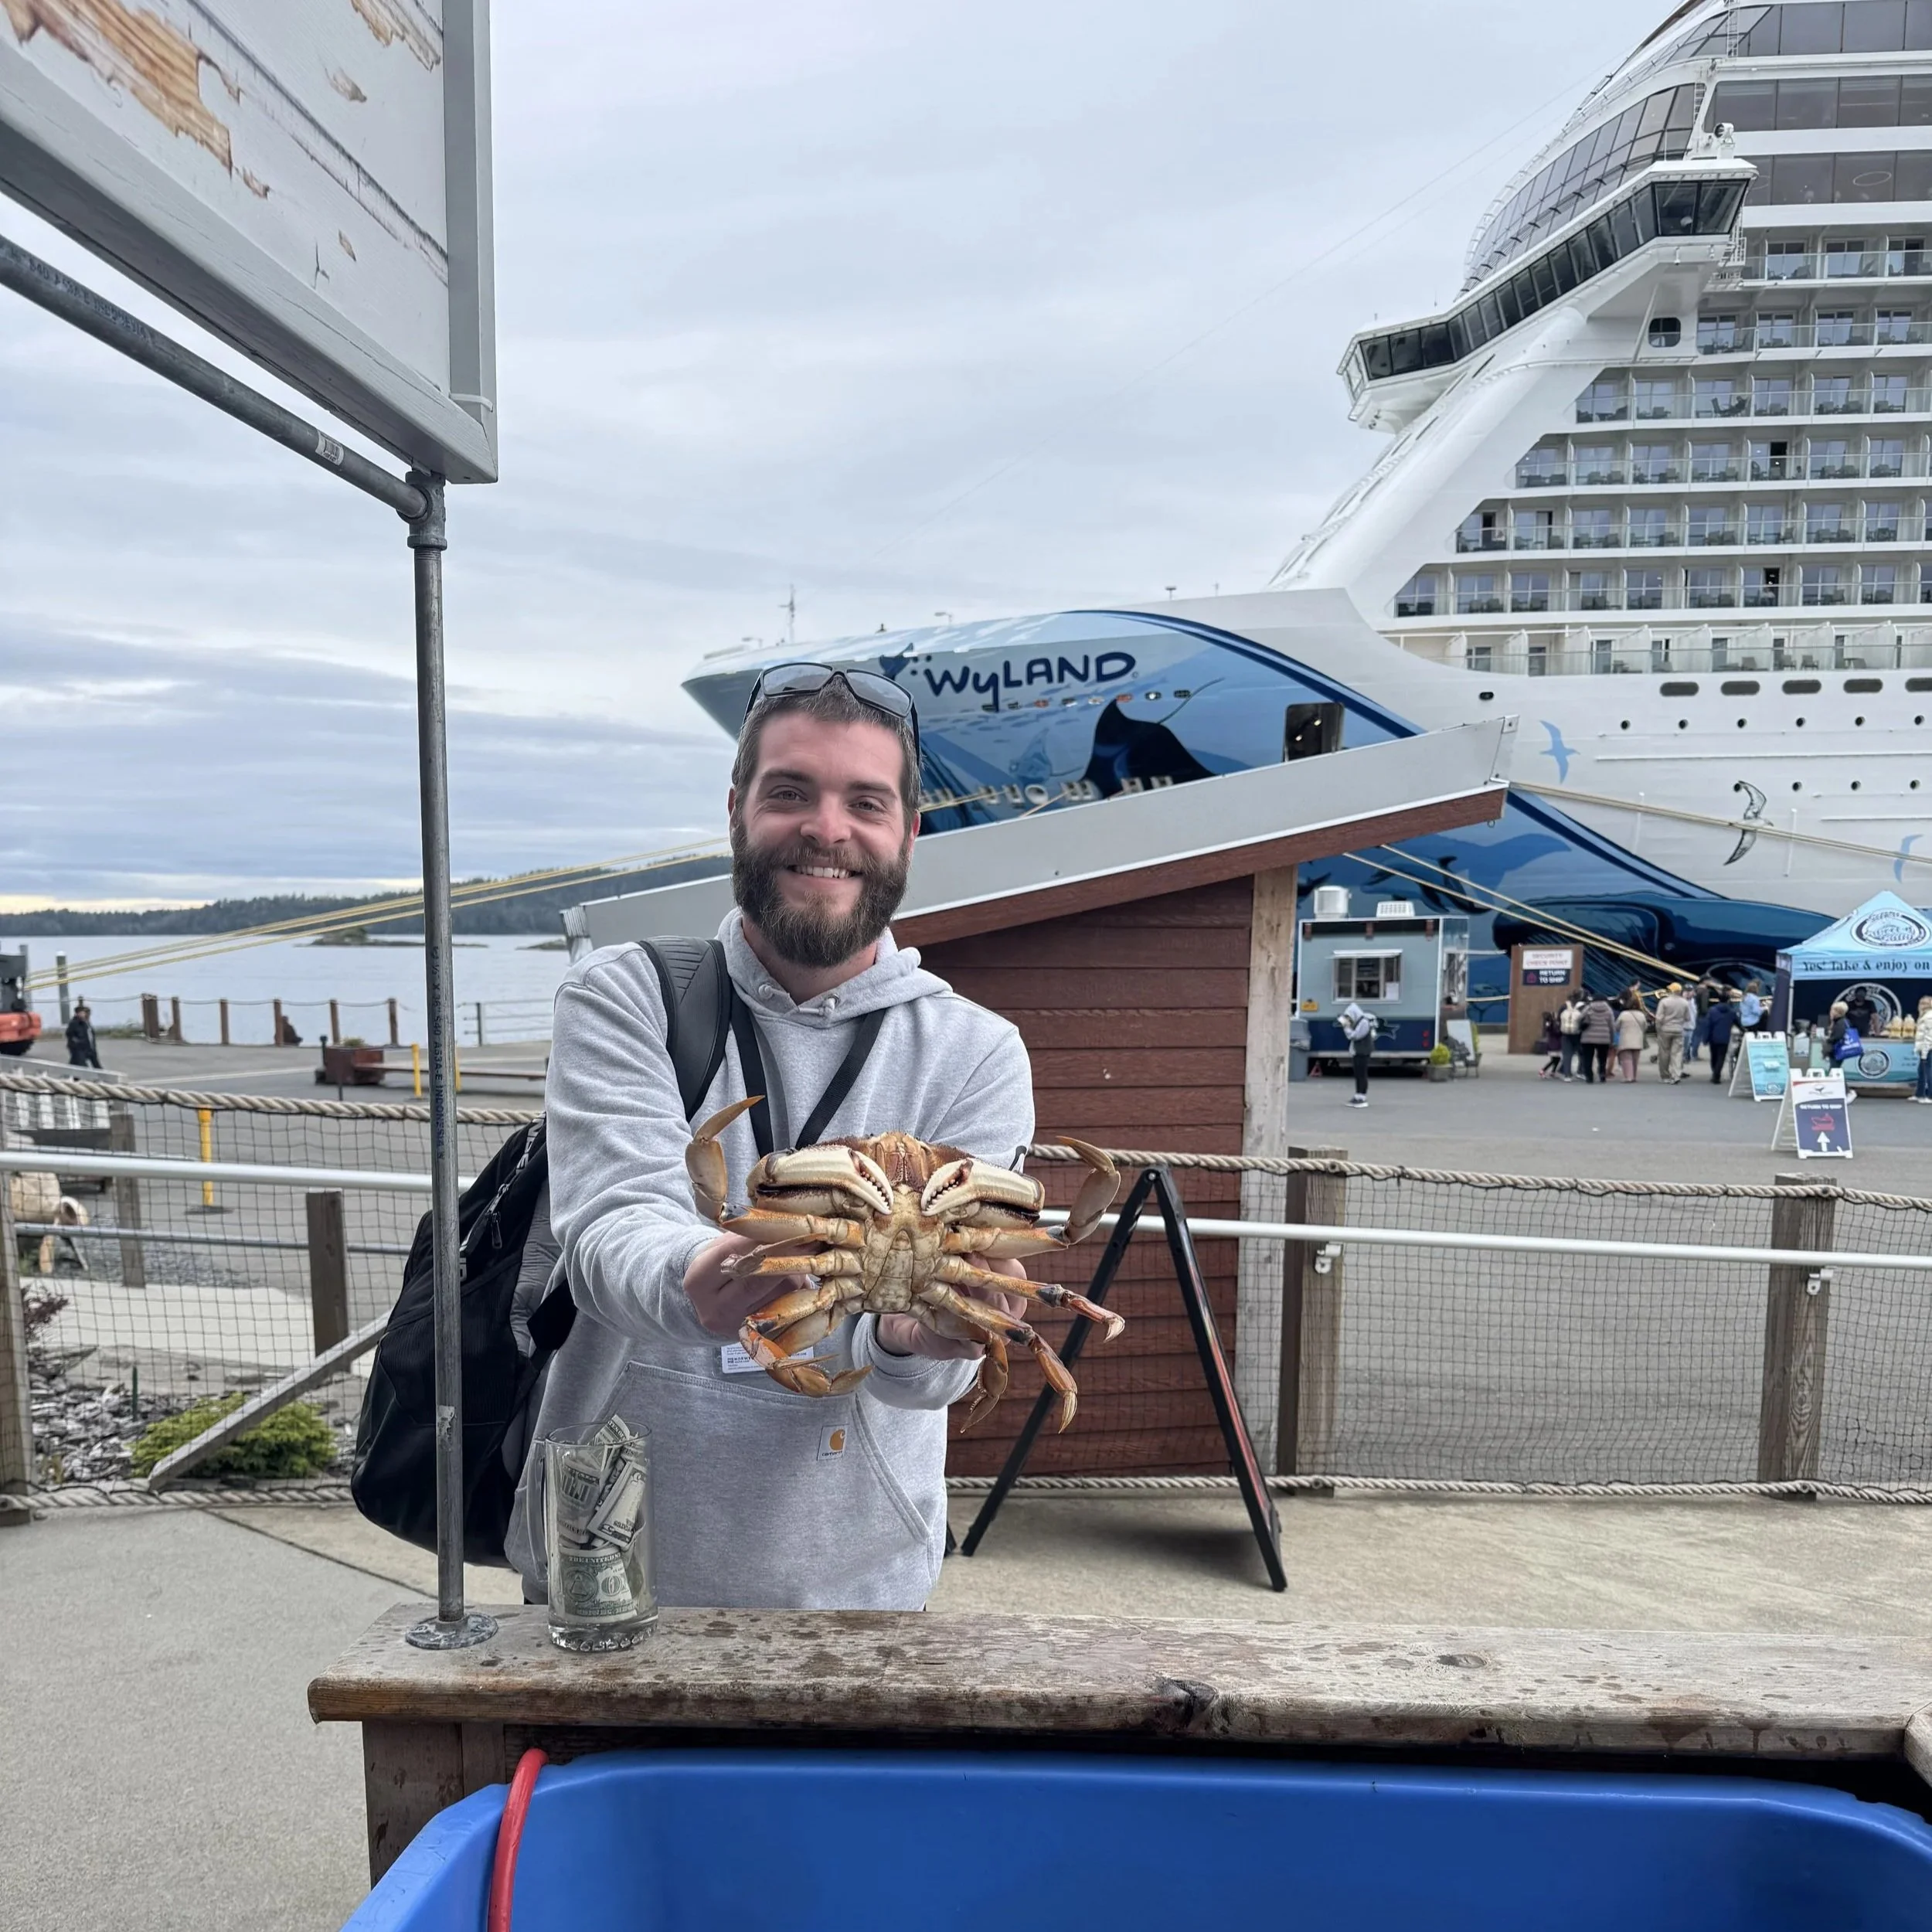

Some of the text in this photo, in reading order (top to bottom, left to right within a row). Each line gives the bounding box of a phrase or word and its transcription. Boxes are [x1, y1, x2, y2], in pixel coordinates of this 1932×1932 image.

[1832, 960, 1859, 971] Take
[1863, 959, 1872, 971] &
[1876, 958, 1907, 973] enjoy
[1914, 961, 1930, 971] on
[435, 1086, 445, 1147] INDONESIA
